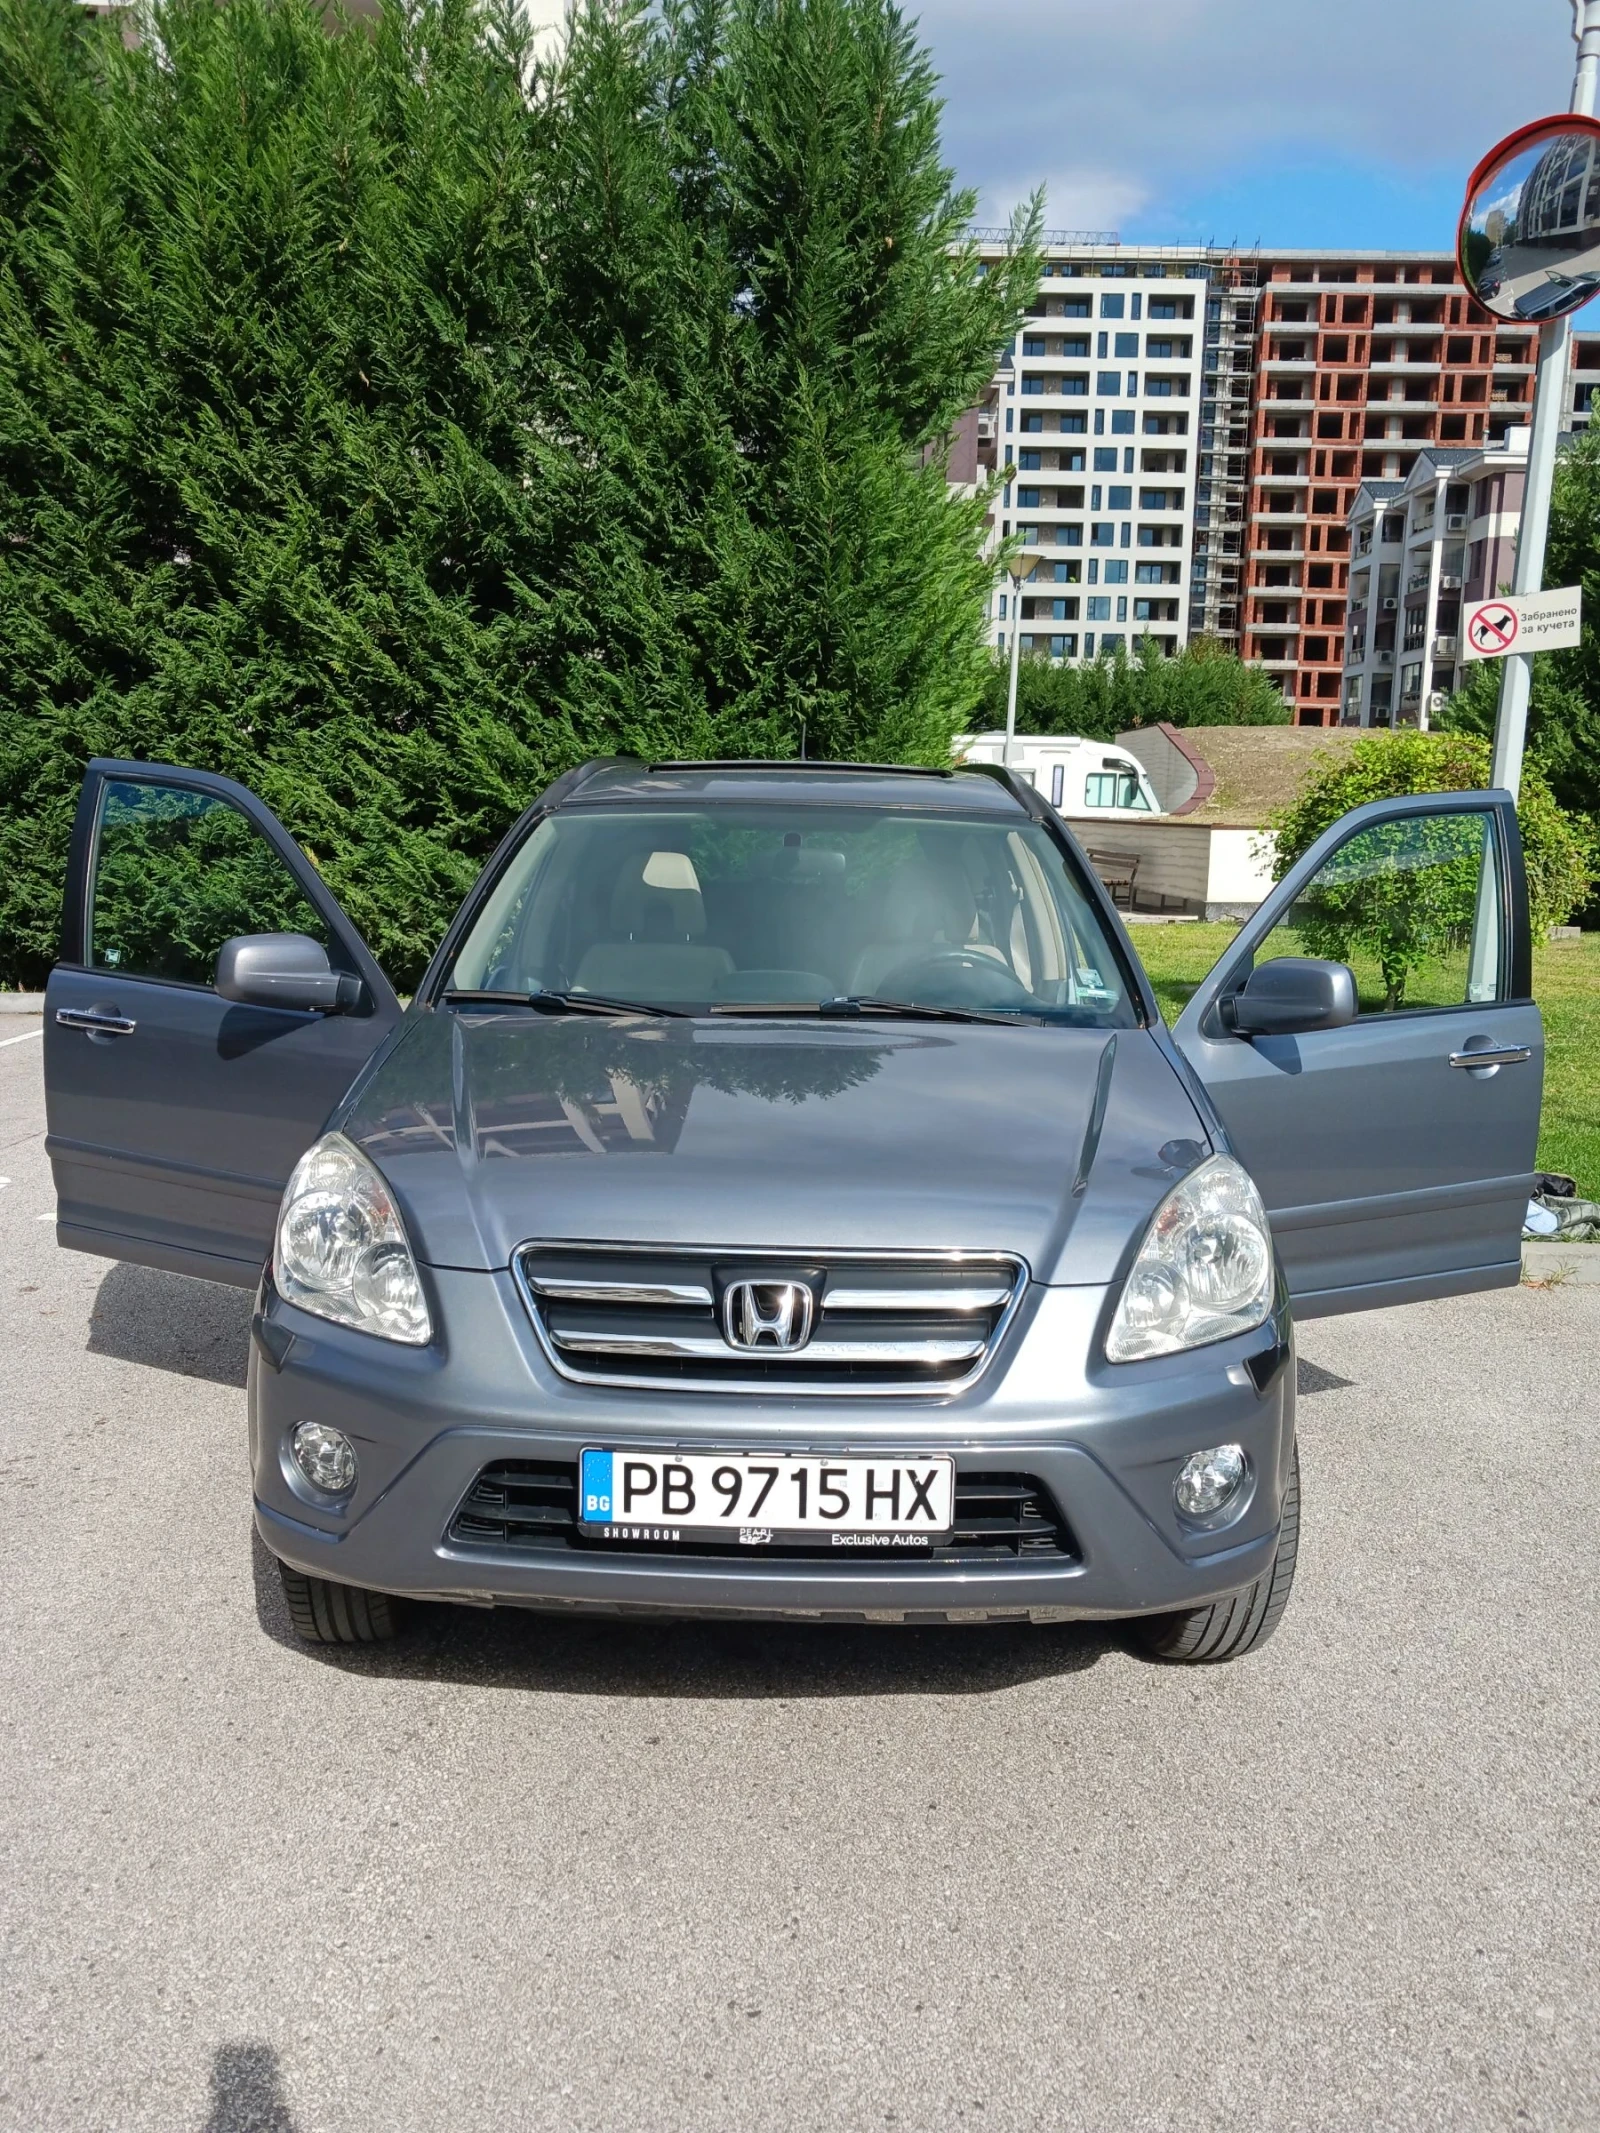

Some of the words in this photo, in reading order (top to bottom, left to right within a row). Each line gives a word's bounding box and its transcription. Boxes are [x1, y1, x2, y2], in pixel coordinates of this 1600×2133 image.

[1521, 608, 1577, 622] Забранено
[1522, 625, 1533, 634] за
[1537, 620, 1575, 633] кучета
[623, 1462, 697, 1516] PB
[711, 1466, 850, 1520] 9715
[865, 1469, 939, 1521] HX
[587, 1495, 610, 1512] BG
[604, 1527, 680, 1541] SHOWROOM
[831, 1533, 890, 1546] Exclusive
[891, 1534, 929, 1546] Autos
